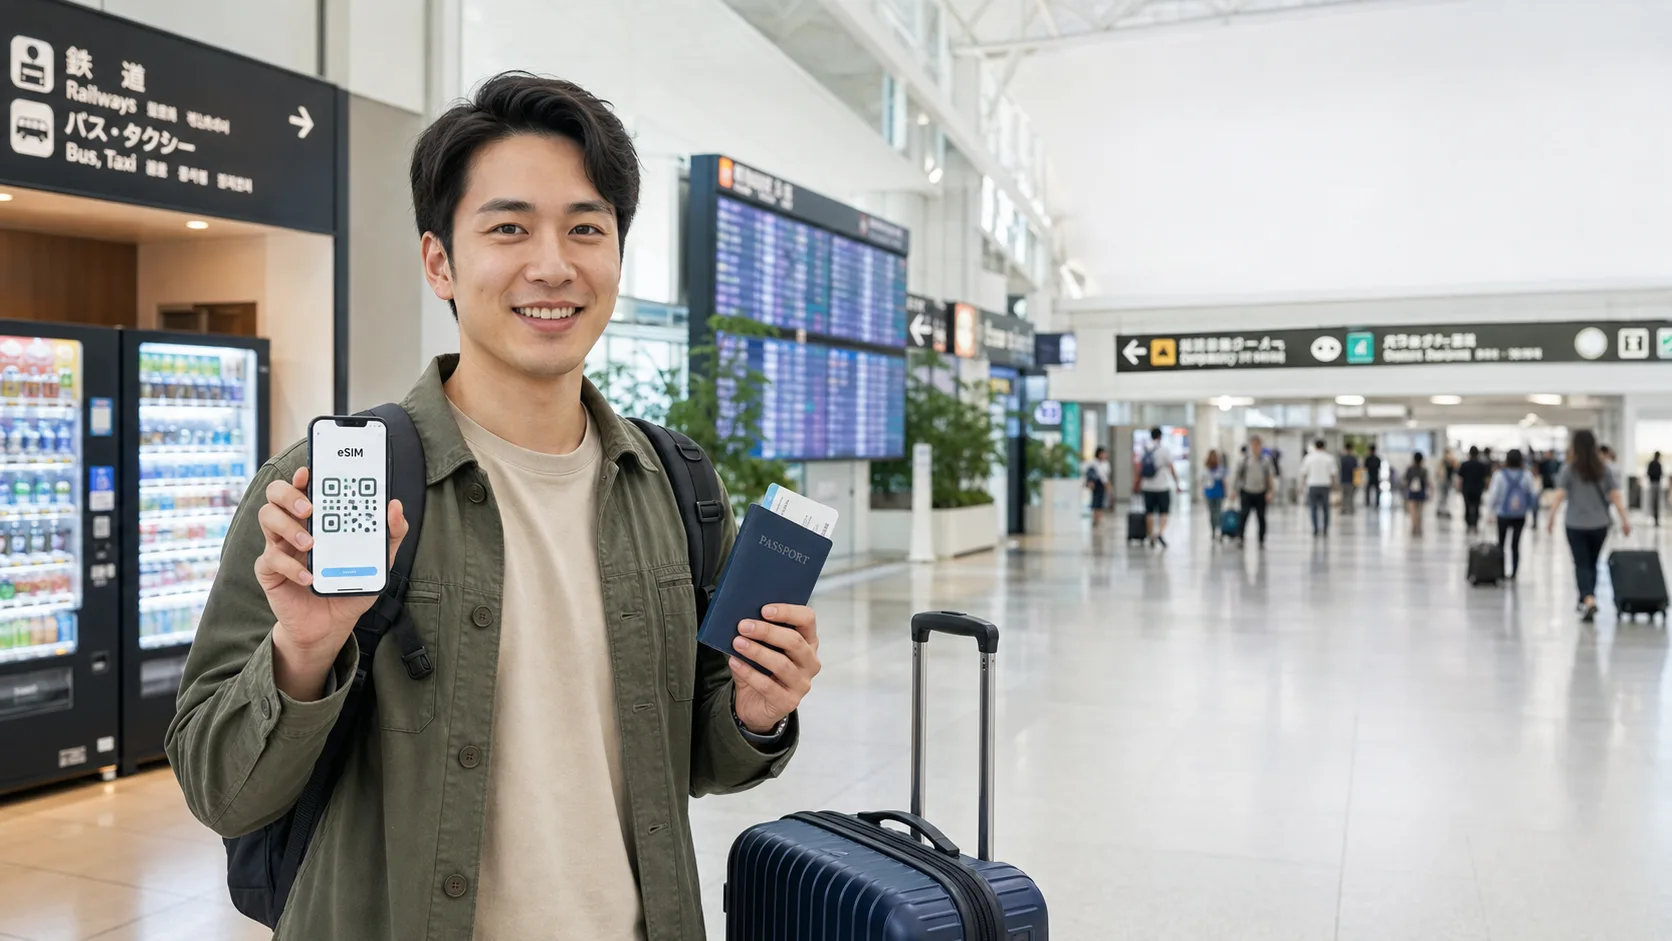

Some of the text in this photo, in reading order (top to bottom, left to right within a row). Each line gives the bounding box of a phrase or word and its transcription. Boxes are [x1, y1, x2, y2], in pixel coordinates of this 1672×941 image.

[66, 79, 137, 115] Railways
[64, 111, 196, 155] バス・タクシー
[66, 141, 101, 169] Bus,
[103, 148, 137, 173] Taxi
[337, 447, 364, 458] eSIM
[759, 534, 811, 565] PASSPORT
